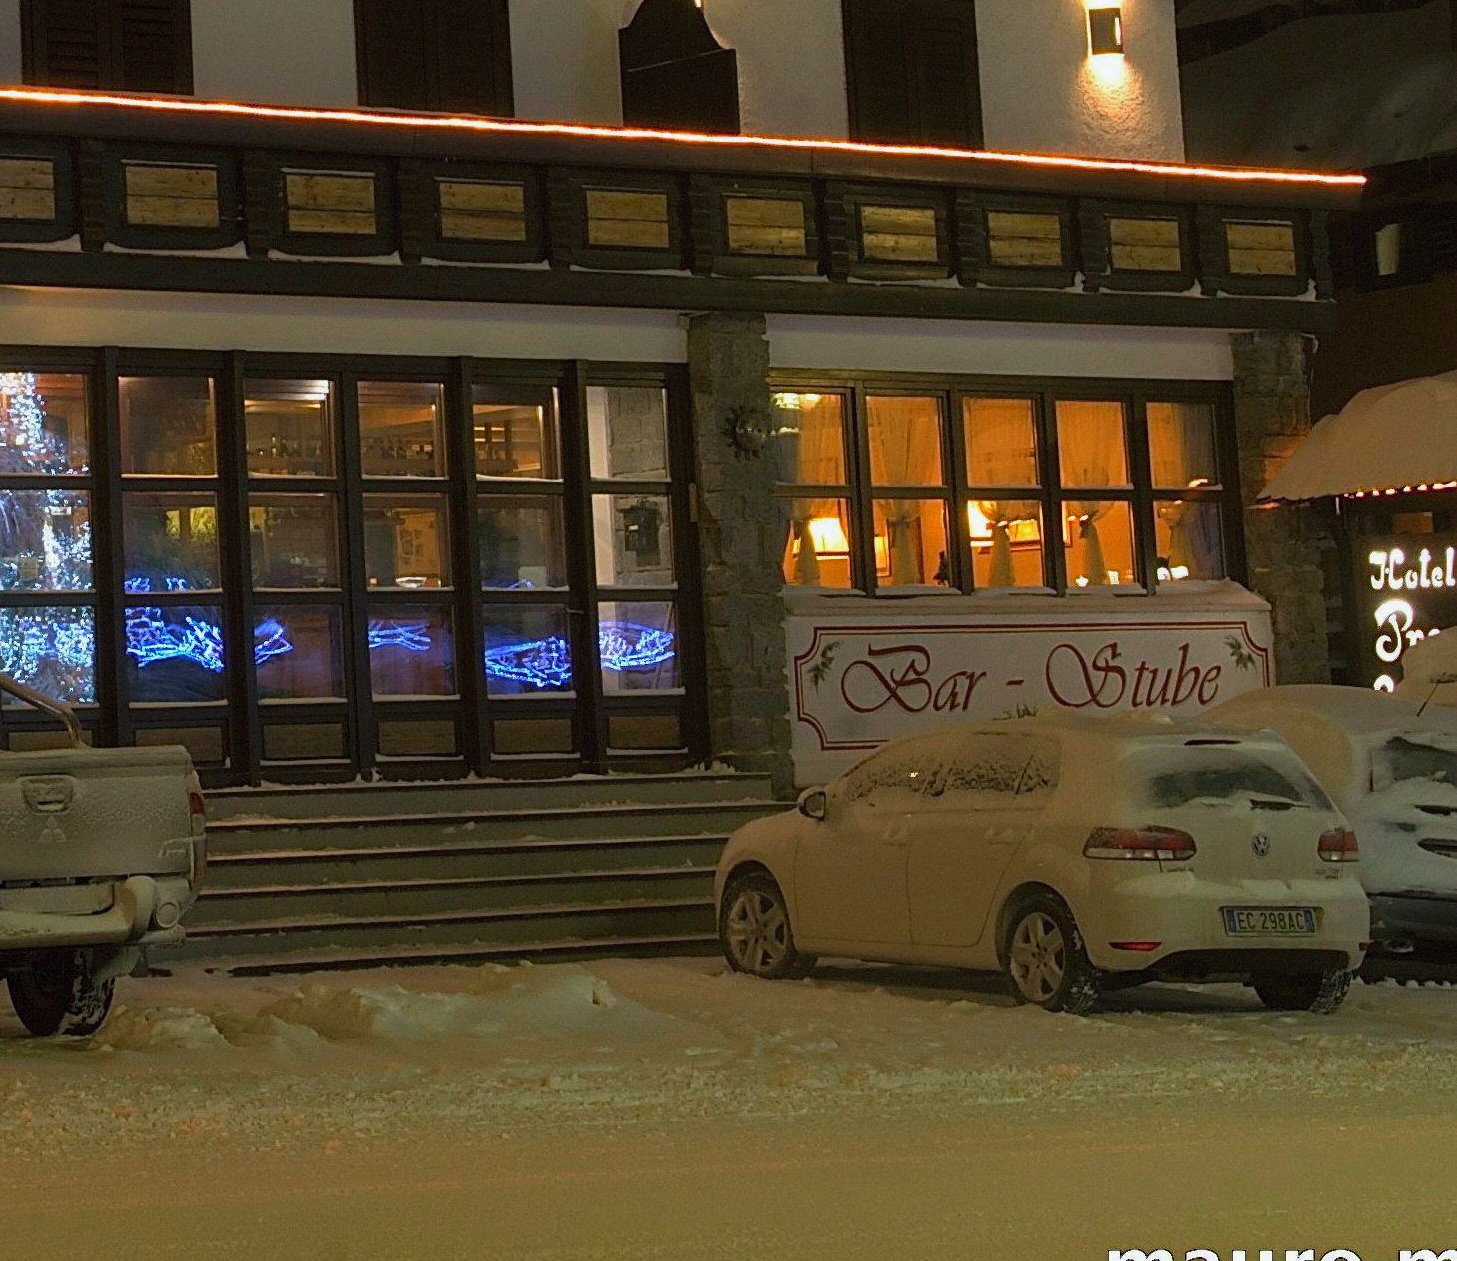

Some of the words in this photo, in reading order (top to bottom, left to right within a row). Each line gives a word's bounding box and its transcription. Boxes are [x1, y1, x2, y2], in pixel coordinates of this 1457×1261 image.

[1369, 546, 1456, 590] Hotel
[840, 642, 987, 714] Bar
[1045, 641, 1223, 710] Stube
[1238, 912, 1256, 930] EC
[1260, 912, 1304, 930] 298AC
